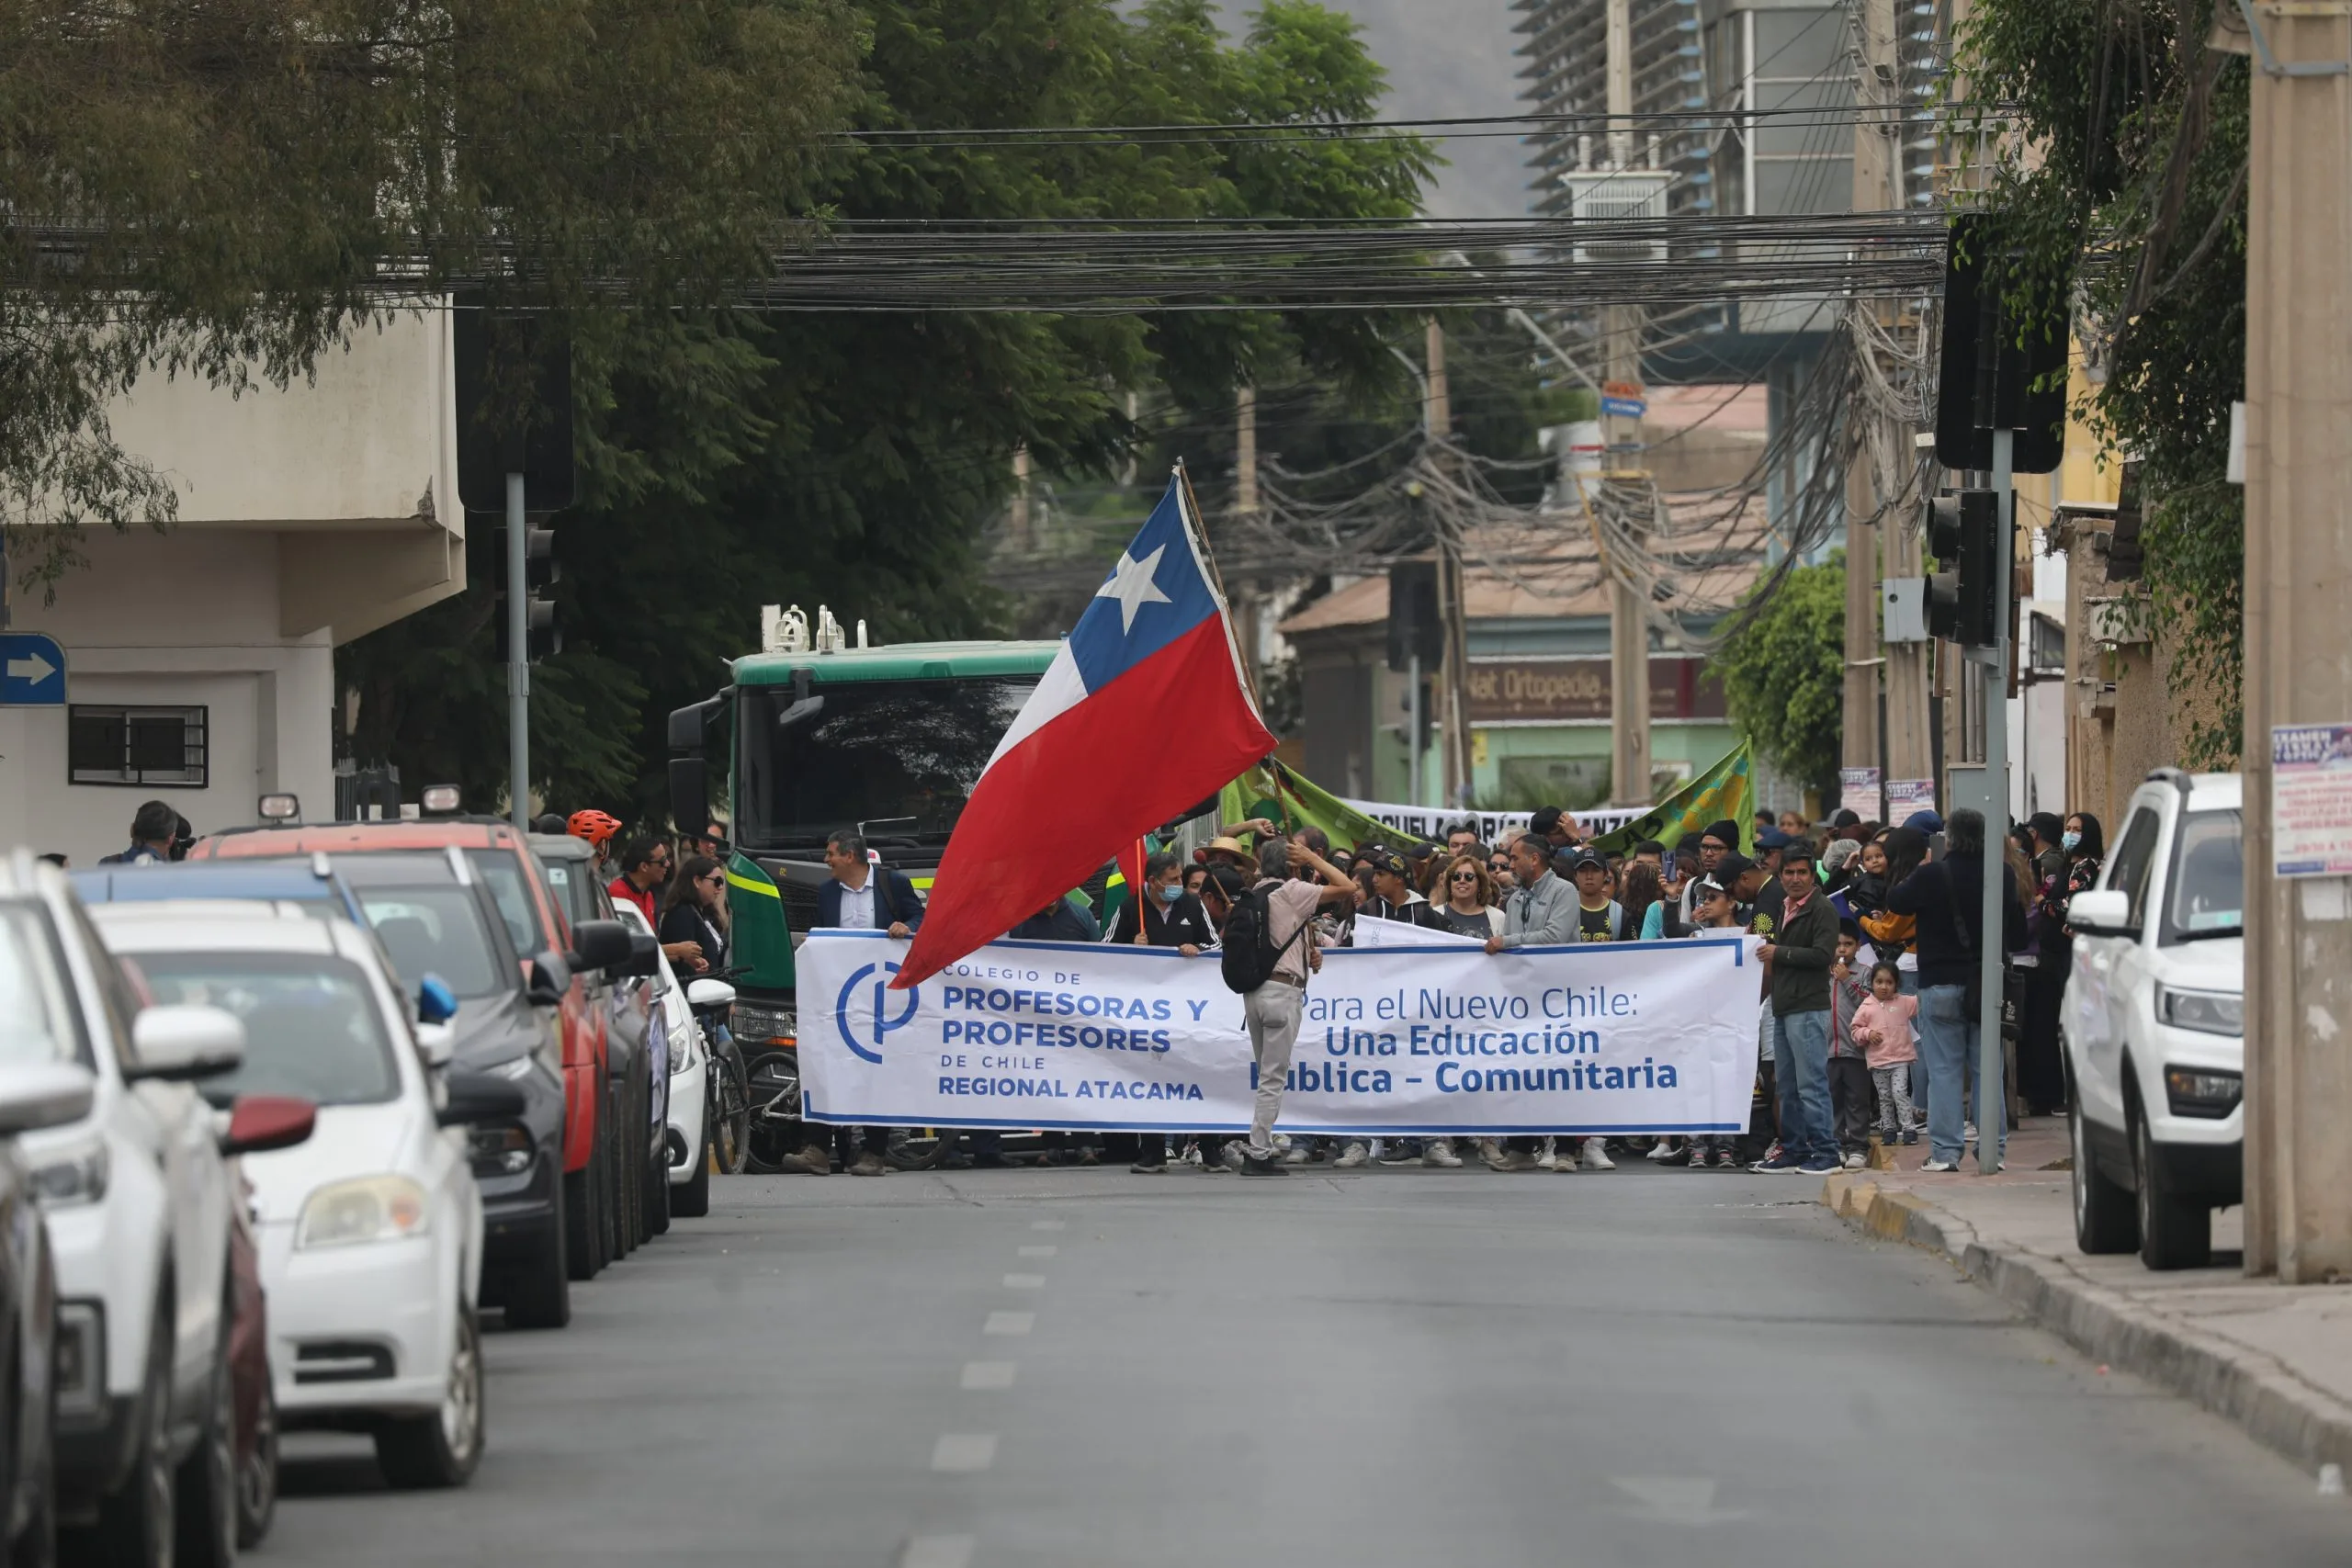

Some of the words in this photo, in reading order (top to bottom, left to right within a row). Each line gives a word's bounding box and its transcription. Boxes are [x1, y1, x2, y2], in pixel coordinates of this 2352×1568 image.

[1504, 670, 1600, 705] Ortopedia
[943, 964, 1039, 982] COLEGIO
[1055, 972, 1080, 985] DE
[944, 986, 1171, 1019] PROFESORAS
[1186, 1000, 1208, 1021] Y
[1375, 988, 1407, 1021] el
[1419, 988, 1531, 1021] Nuevo
[1539, 985, 1639, 1019] Chile:
[943, 1019, 1171, 1054] PROFESORES
[1326, 1026, 1397, 1056] Una
[1410, 1023, 1600, 1055] Educación
[941, 1055, 967, 1069] DE
[982, 1055, 1045, 1070] CHILE
[1433, 1058, 1679, 1095] Comunitaria
[938, 1077, 1068, 1099] REGIONAL
[1075, 1080, 1204, 1101] ATACAMA
